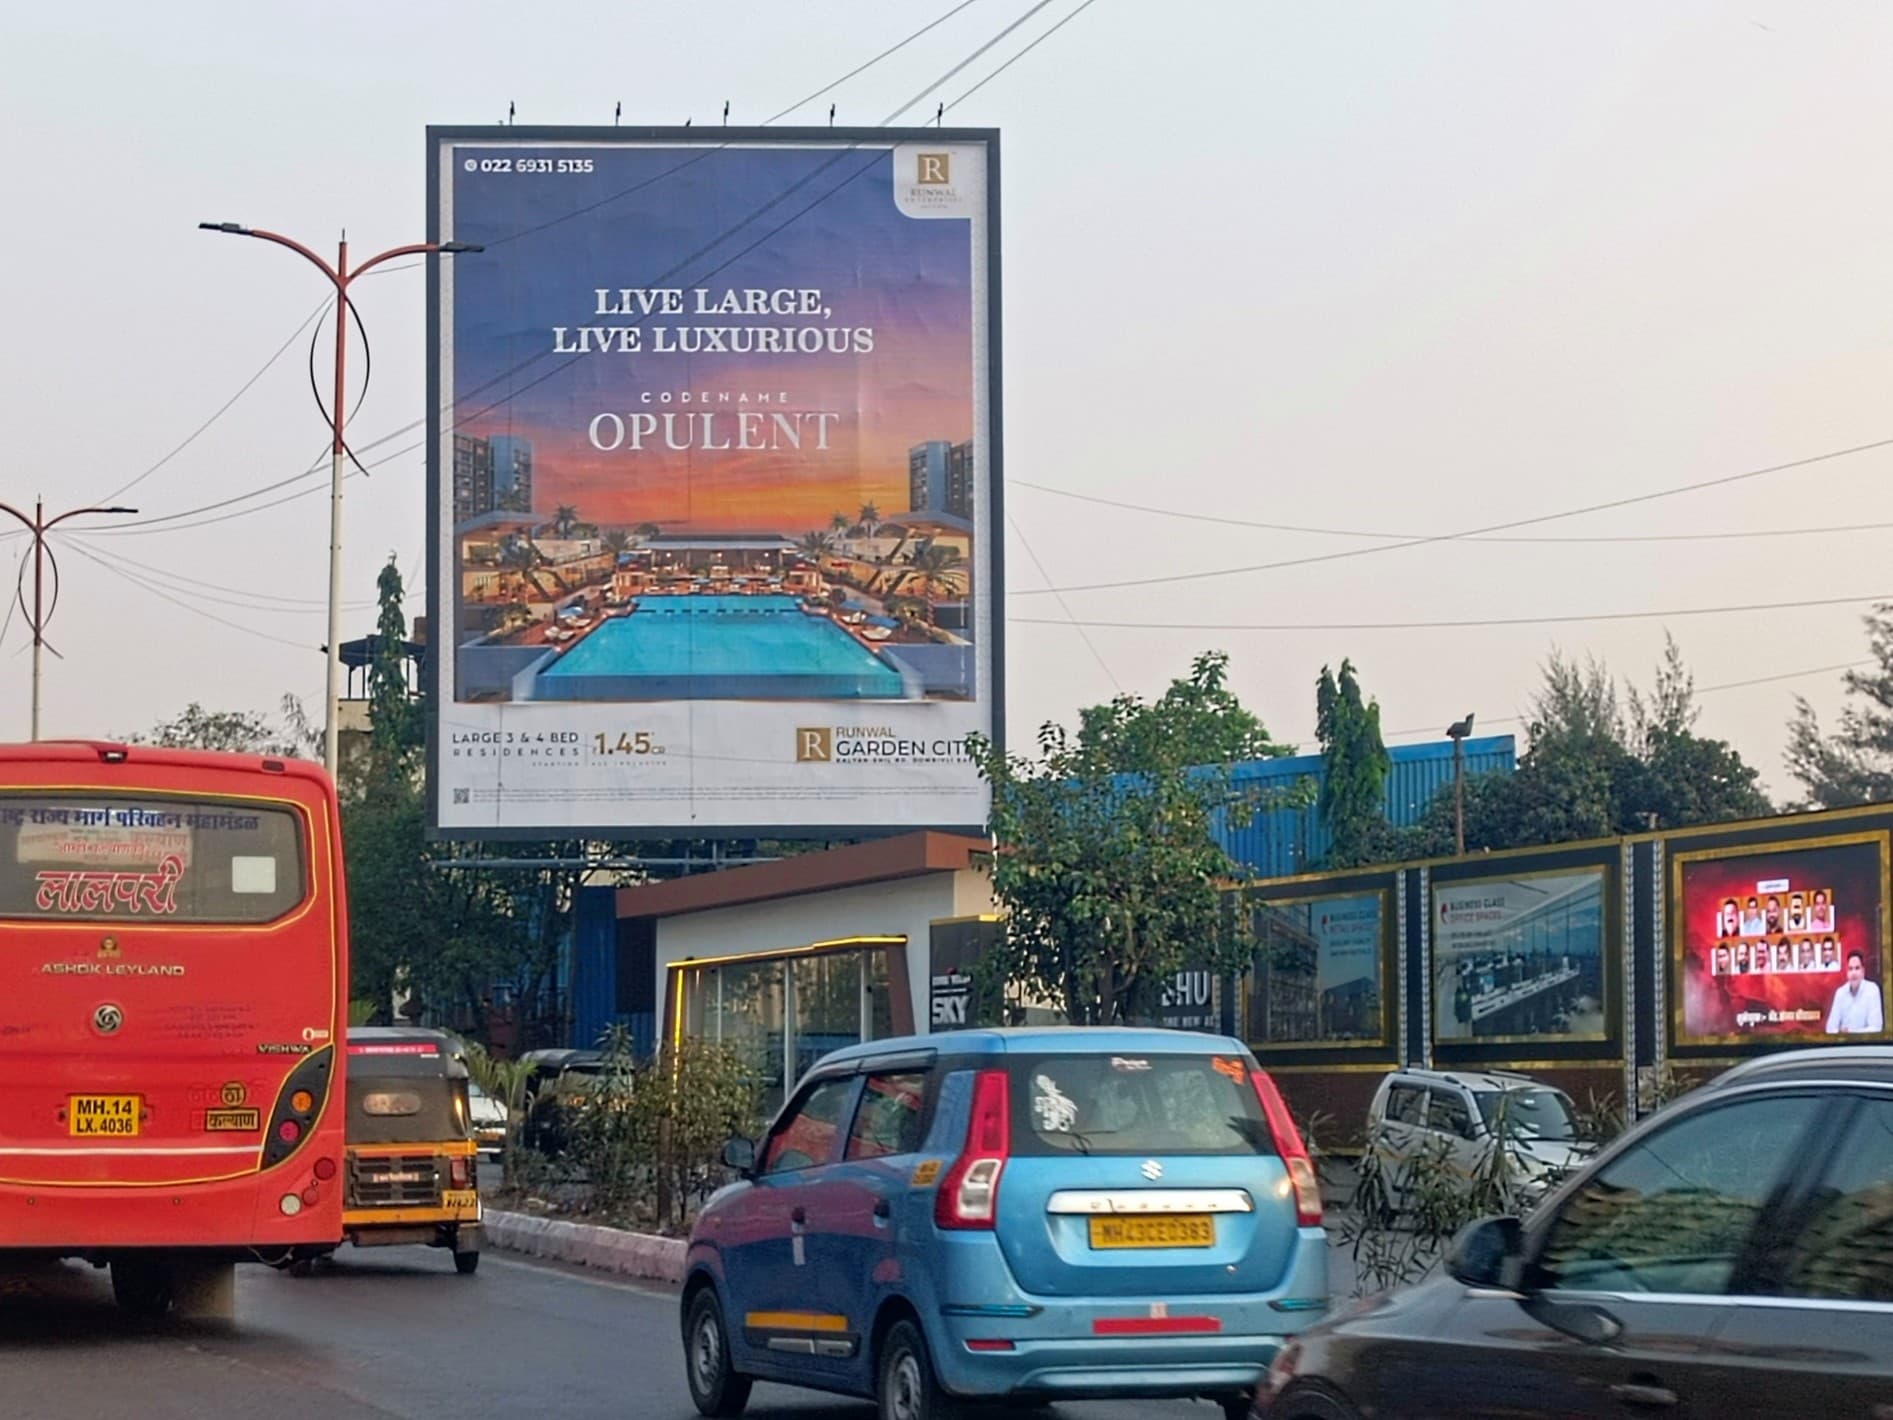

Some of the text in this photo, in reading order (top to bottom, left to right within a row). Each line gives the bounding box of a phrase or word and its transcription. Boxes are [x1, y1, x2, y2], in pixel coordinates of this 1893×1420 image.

[480, 159, 594, 173] 022 6931 5135
[595, 289, 832, 319] LIVE LARGE,
[552, 327, 875, 353] LIVE LUXURIOUS
[640, 391, 789, 404] CODENAME
[588, 412, 840, 451] OPULENT
[452, 732, 579, 744] LARGE 3 & 4 BED
[835, 727, 897, 739] RUNWAL
[453, 747, 579, 757] RESIDENCES
[836, 740, 974, 757] GARDEN CIT
[74, 806, 111, 827] मार्ग
[116, 803, 182, 829] परिवहन
[35, 855, 184, 915] लालपरी
[41, 964, 185, 976] ASHOK LEYLAND
[932, 996, 970, 1025] SKY
[258, 1044, 311, 1054] VISHWA
[77, 1099, 132, 1116] MH.14
[208, 1112, 256, 1127] कल्याण
